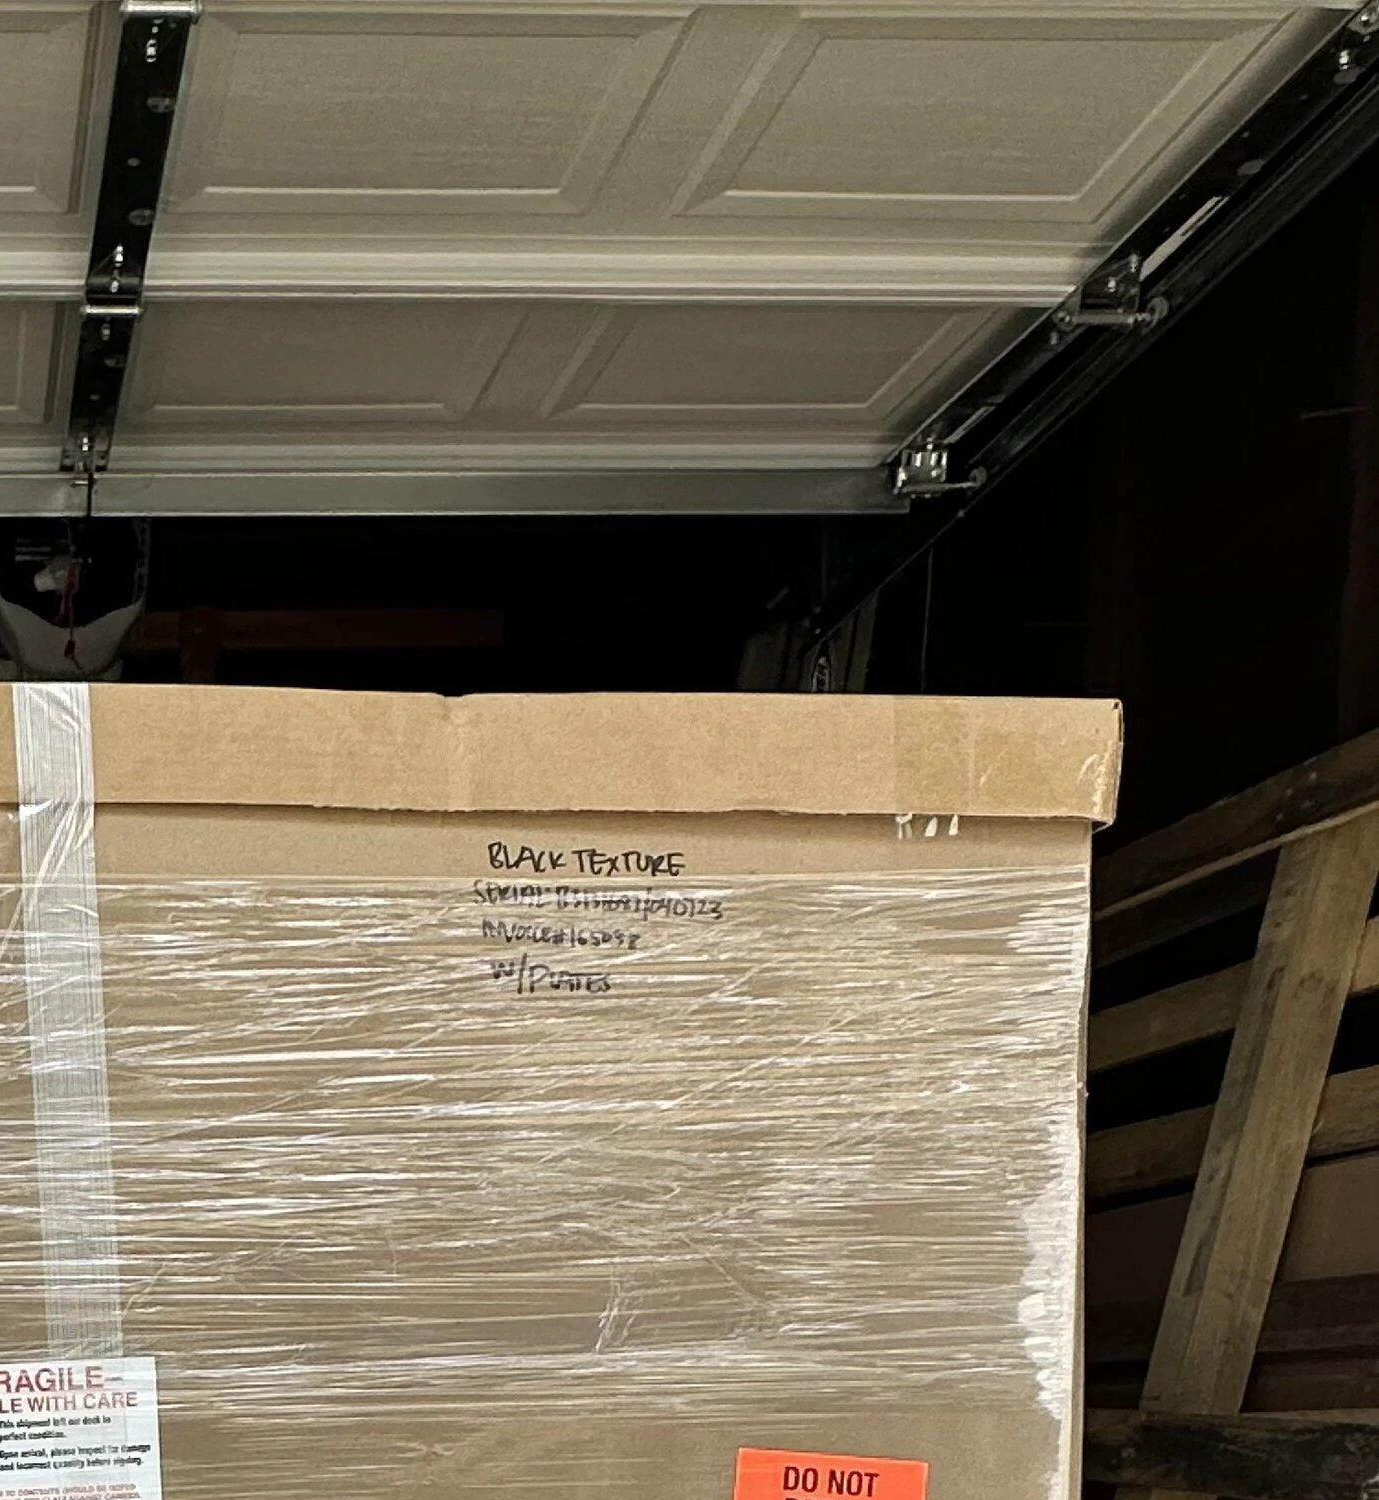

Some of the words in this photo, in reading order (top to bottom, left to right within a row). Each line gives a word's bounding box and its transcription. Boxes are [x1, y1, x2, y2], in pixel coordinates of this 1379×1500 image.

[488, 841, 567, 873] BLACK
[572, 848, 686, 877] TEXTURE
[28, 1394, 76, 1413] WITH
[83, 1391, 139, 1409] CARE
[783, 1466, 819, 1493] DO
[827, 1469, 879, 1497] NOT
